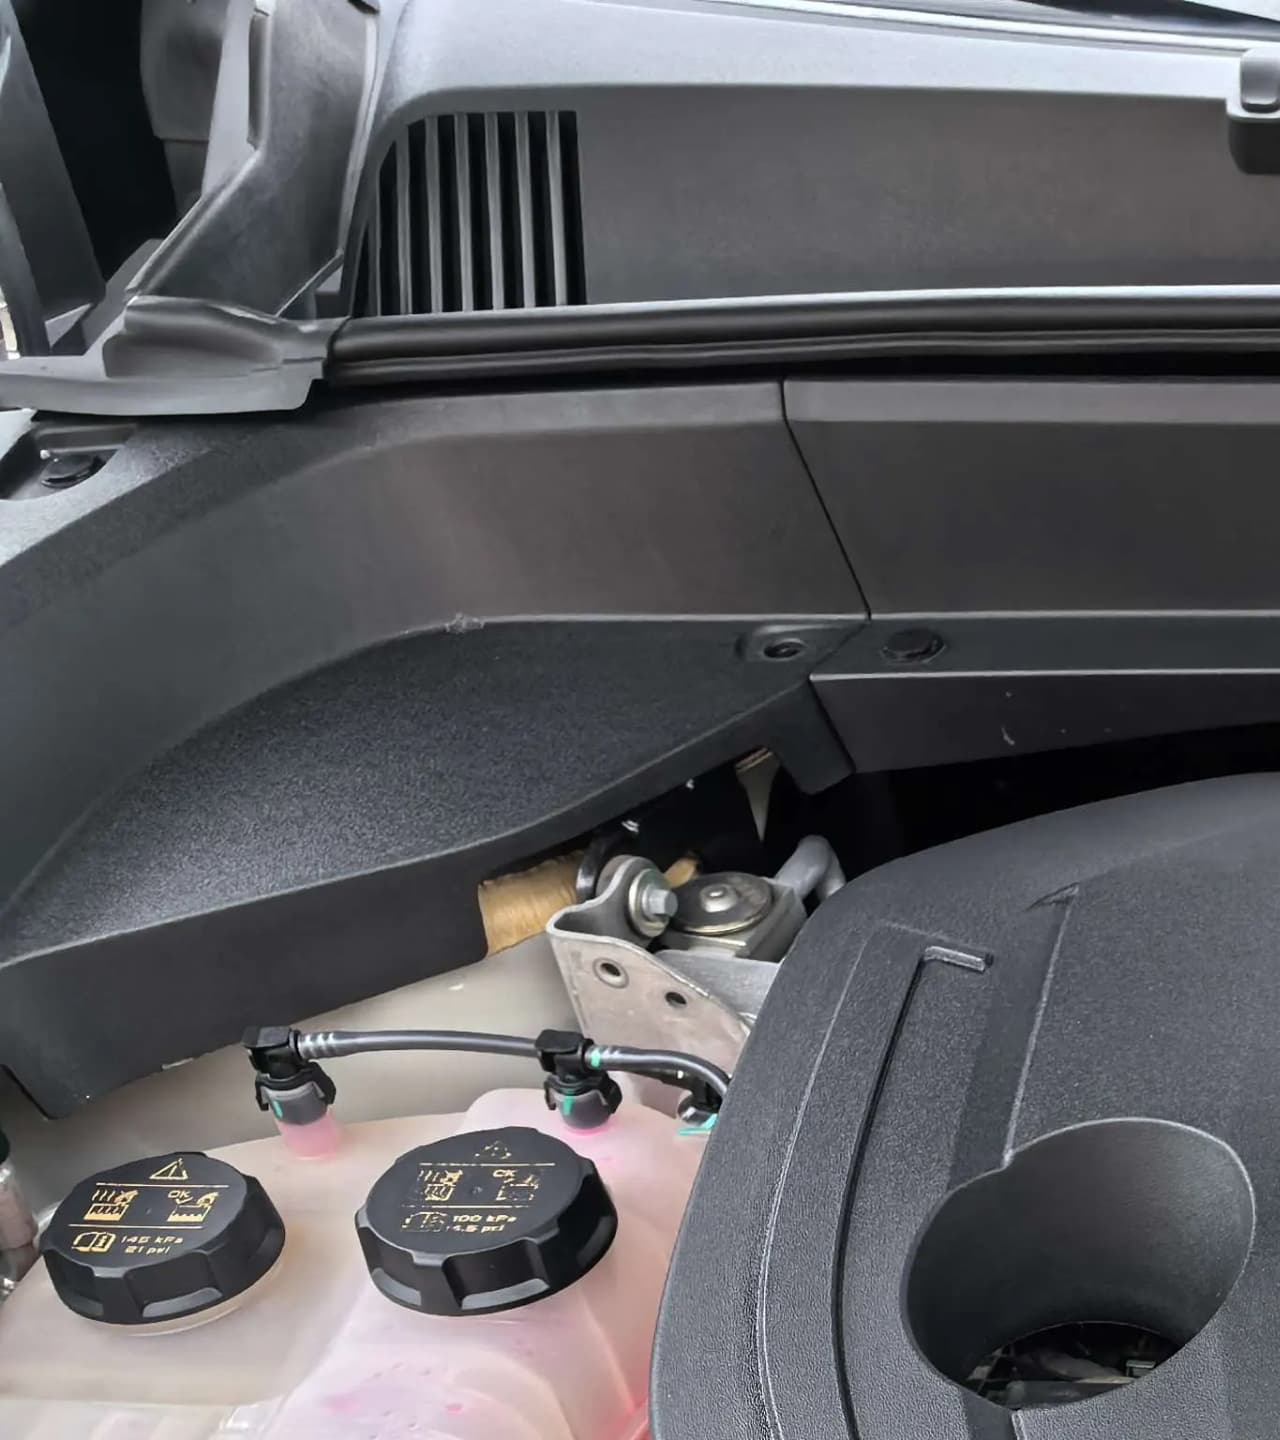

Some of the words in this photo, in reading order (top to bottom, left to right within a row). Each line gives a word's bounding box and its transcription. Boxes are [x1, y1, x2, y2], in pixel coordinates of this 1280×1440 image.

[168, 1189, 191, 1199] OK
[452, 1214, 482, 1223] 100
[121, 1235, 152, 1244] 145
[154, 1235, 184, 1244] kPa
[124, 1246, 143, 1254] 21
[145, 1246, 170, 1257] psi
